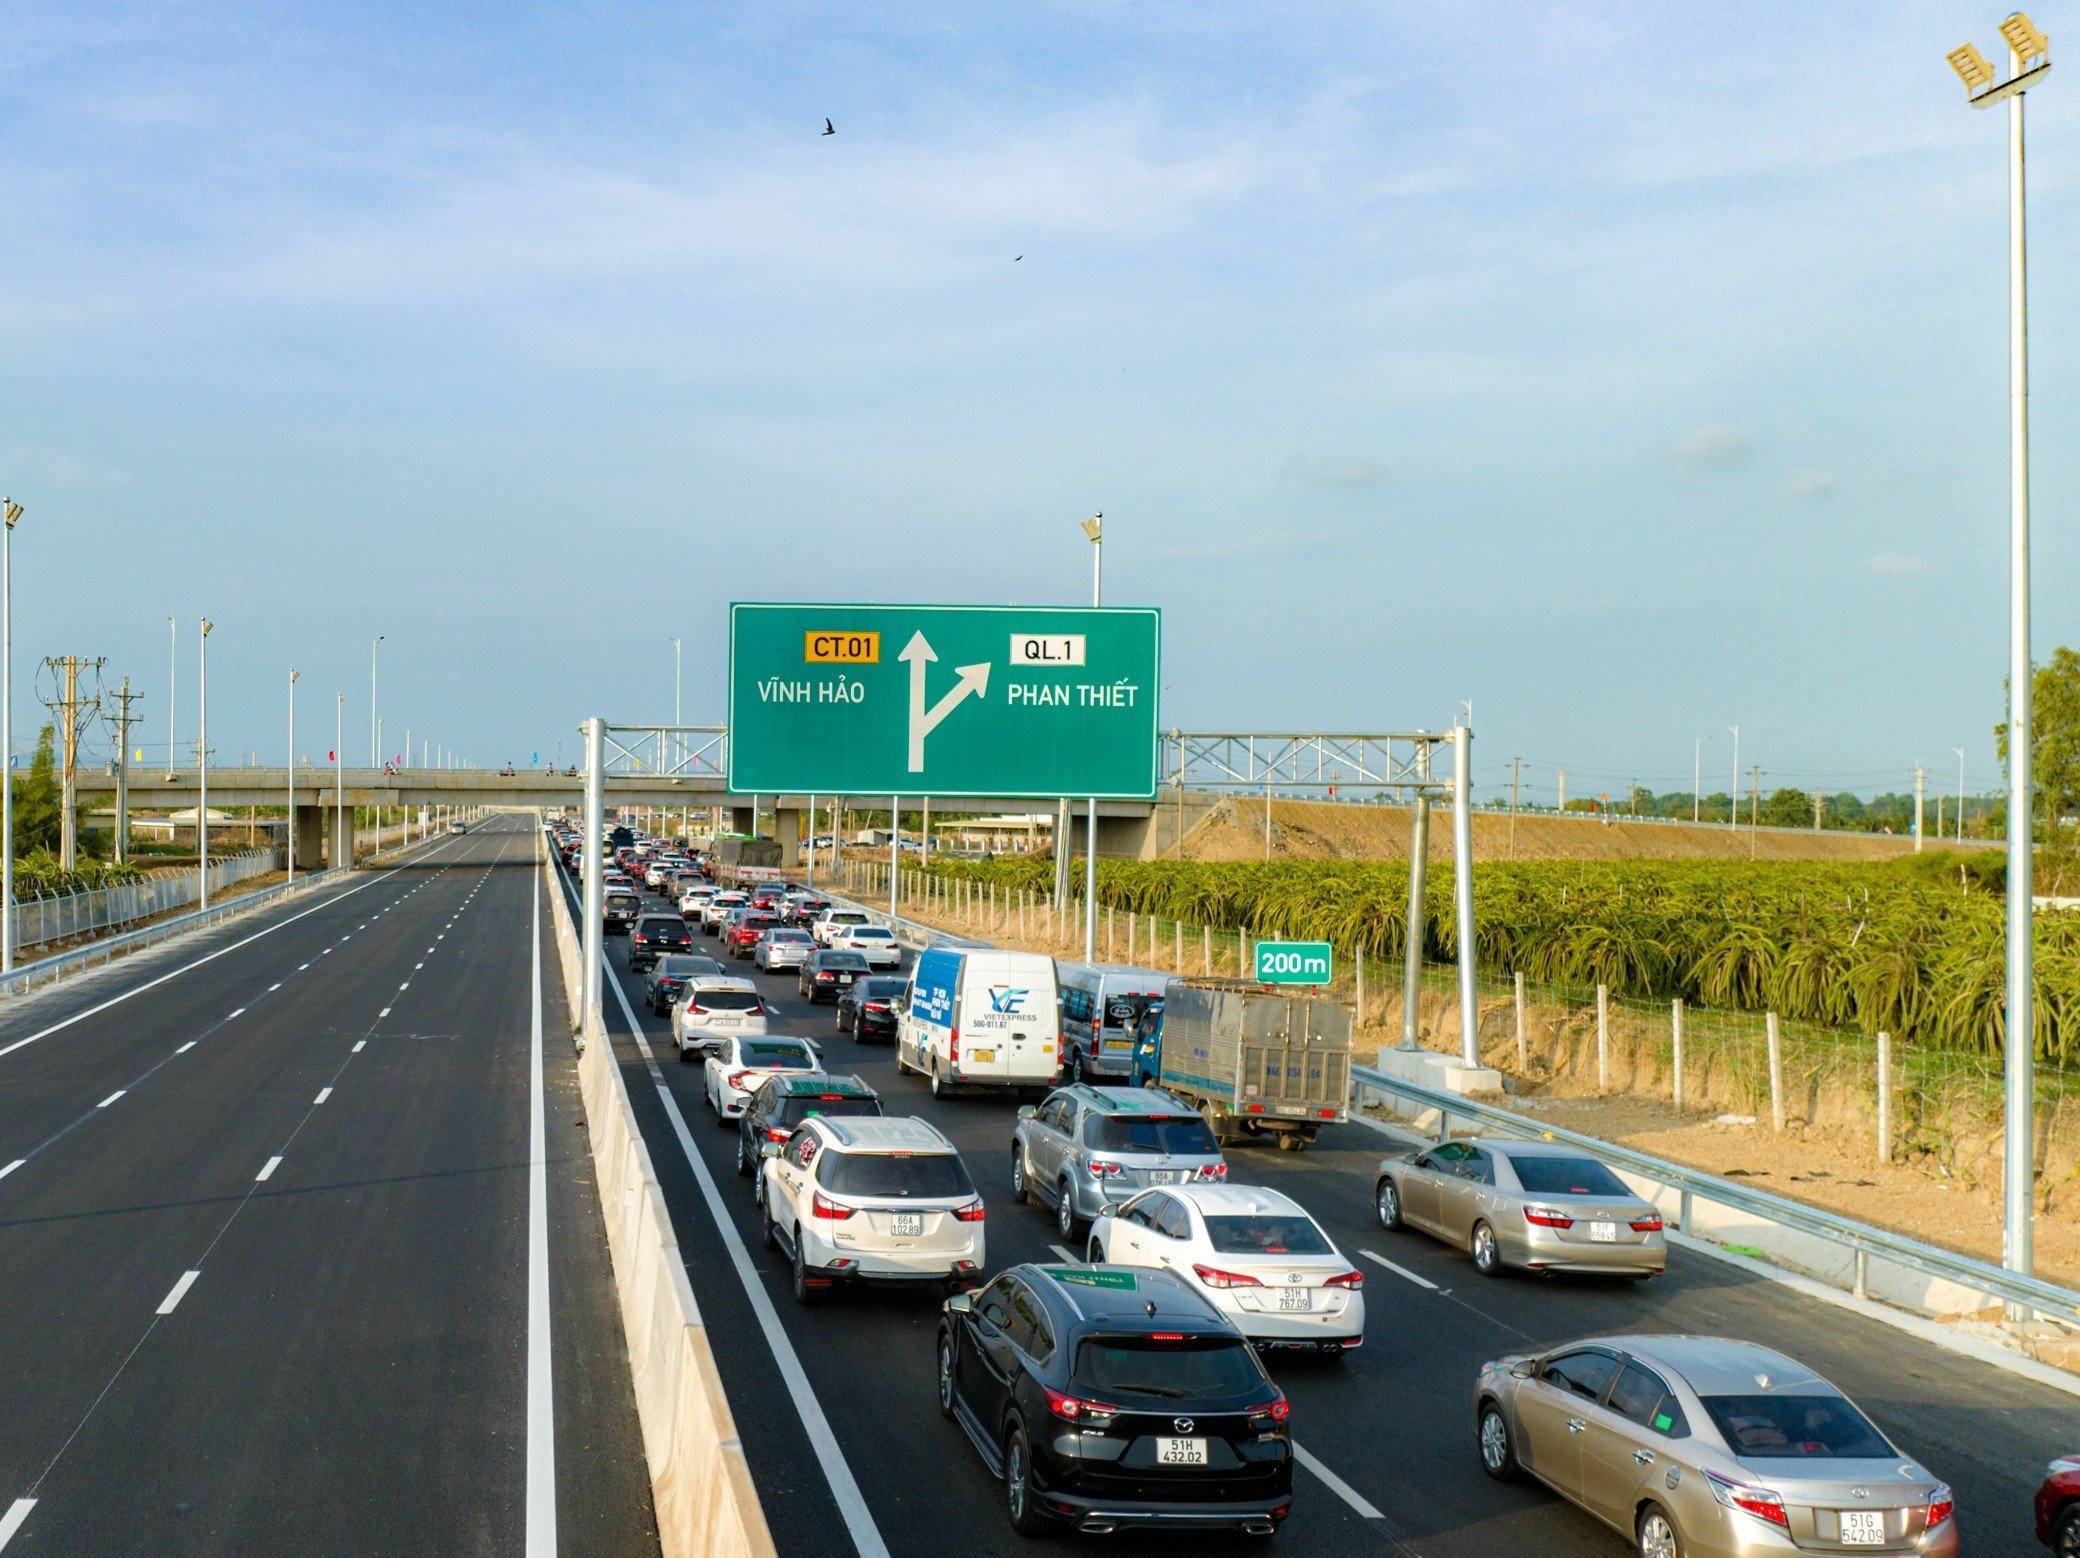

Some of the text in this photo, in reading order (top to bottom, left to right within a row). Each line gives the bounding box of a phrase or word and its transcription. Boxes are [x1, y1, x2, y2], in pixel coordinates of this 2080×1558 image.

[814, 636, 871, 657] CT.01
[1025, 640, 1071, 660] QL.1
[758, 674, 865, 704] VĨNH HẢO
[1008, 677, 1139, 707] PHAN THIẾT
[983, 1013, 1037, 1022] VIETEXPRESS
[973, 1020, 1008, 1029] 50G-011.67
[897, 1215, 913, 1225] 66A
[1284, 1288, 1301, 1298] 51H
[1171, 1440, 1193, 1451] 51H
[1163, 1452, 1202, 1463] 432.02
[1850, 1514, 1873, 1528] 51G
